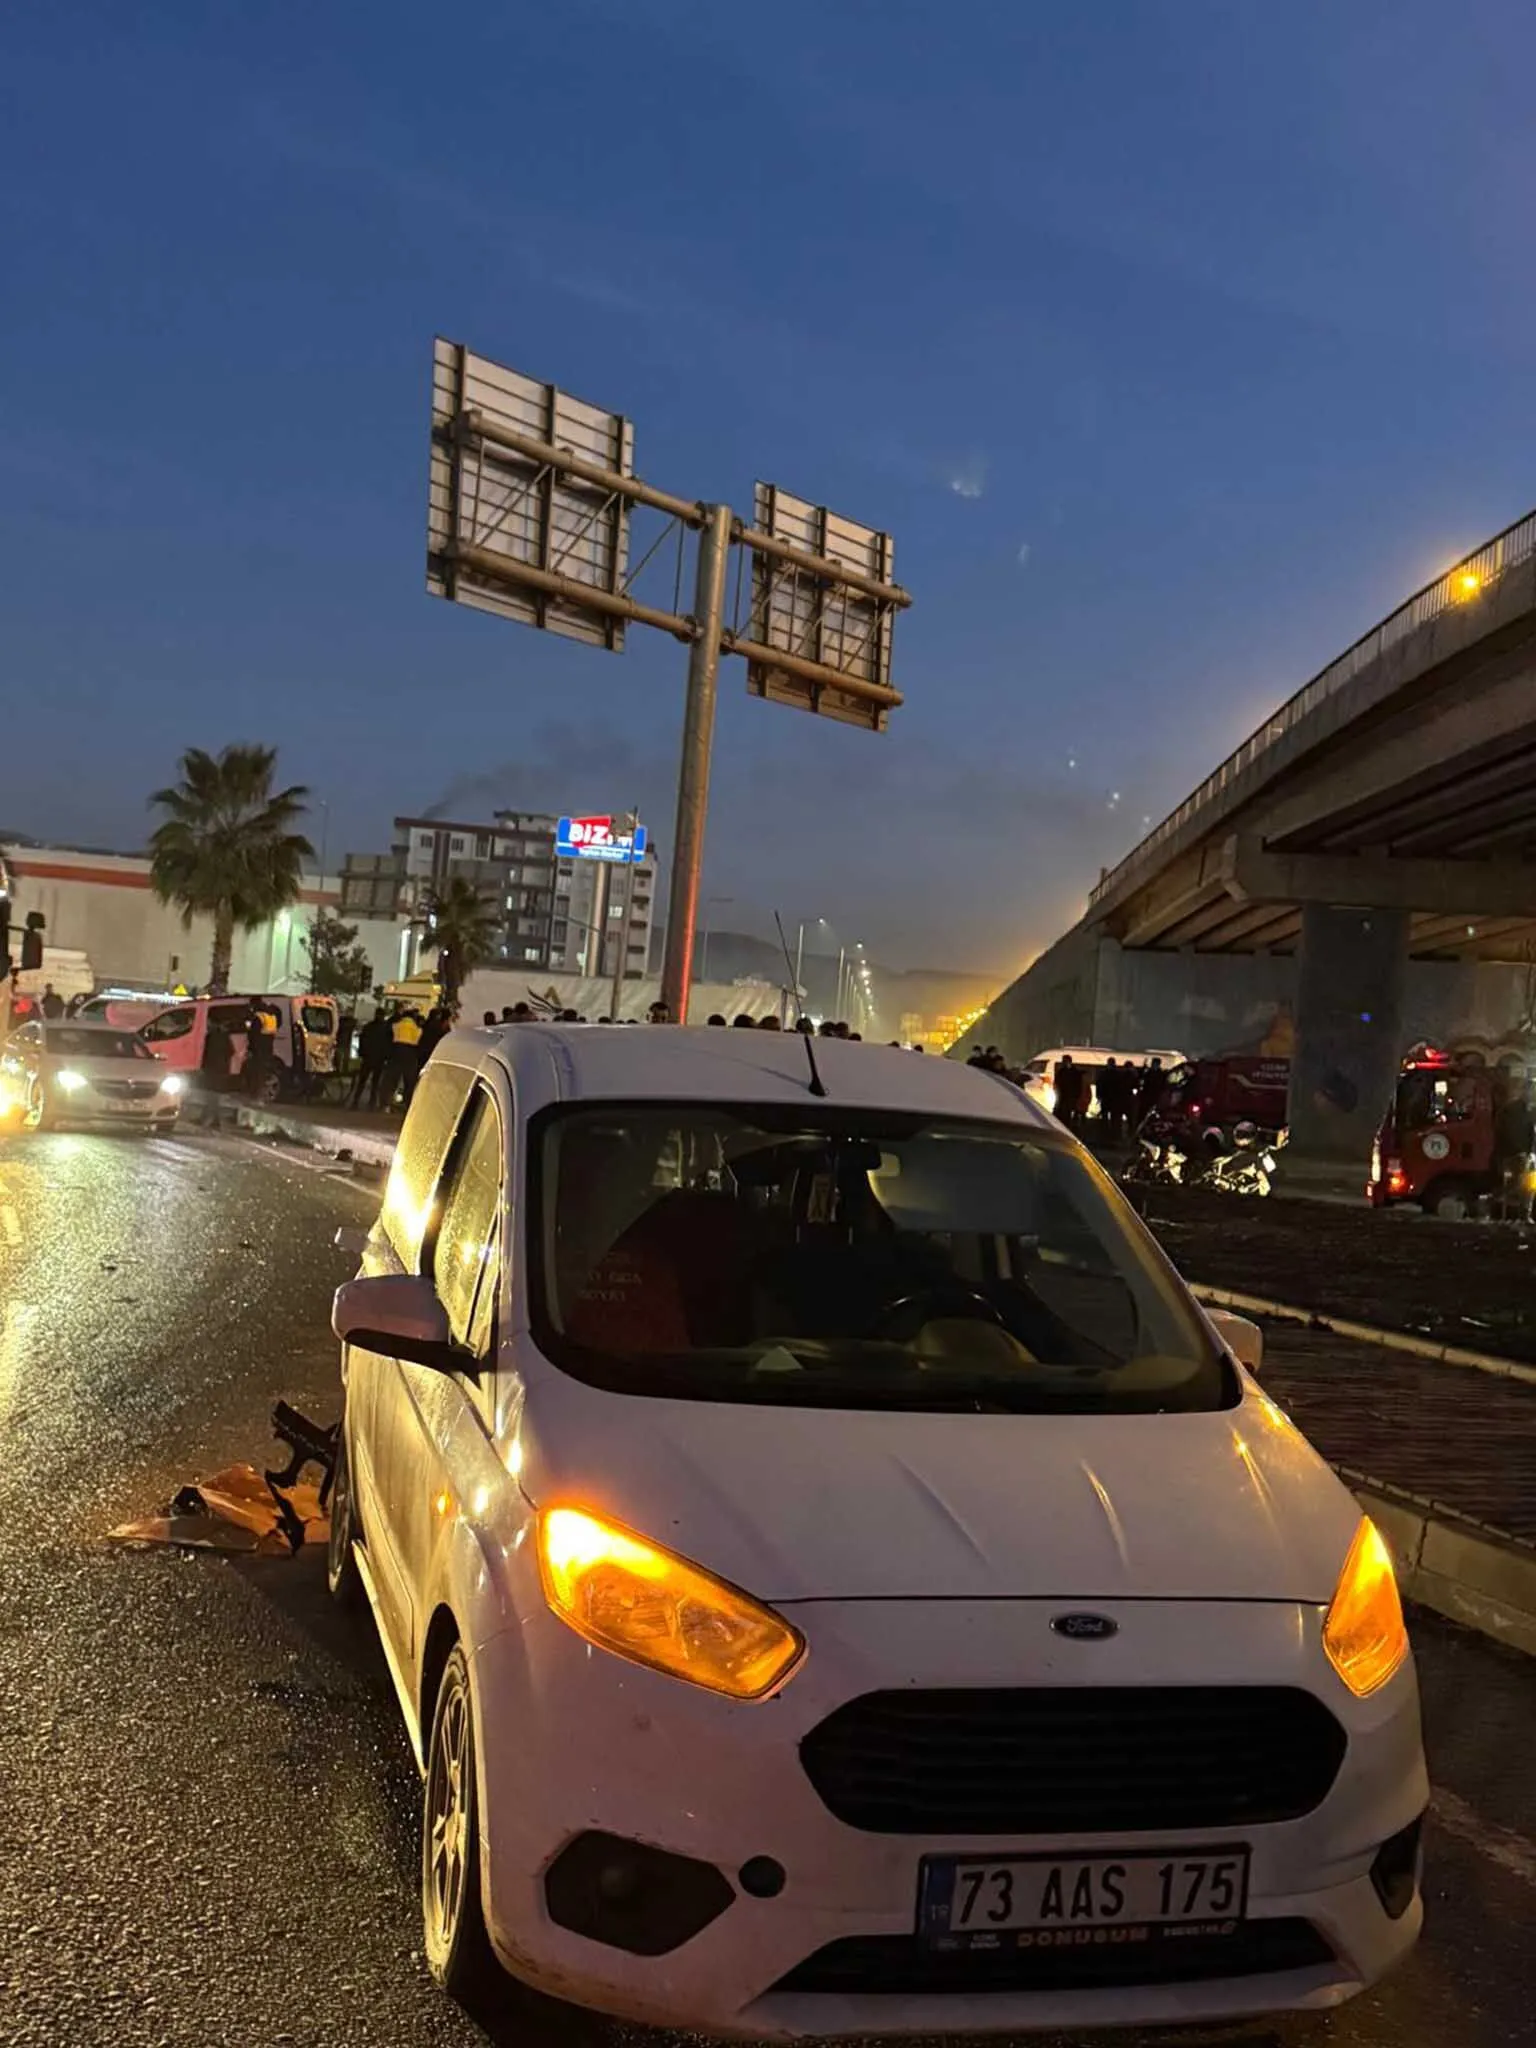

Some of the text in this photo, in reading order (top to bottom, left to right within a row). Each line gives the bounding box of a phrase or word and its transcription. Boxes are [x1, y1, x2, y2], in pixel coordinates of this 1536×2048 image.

[1066, 1617, 1104, 1633] Ford
[958, 1861, 1238, 1924] 73 AAS 175
